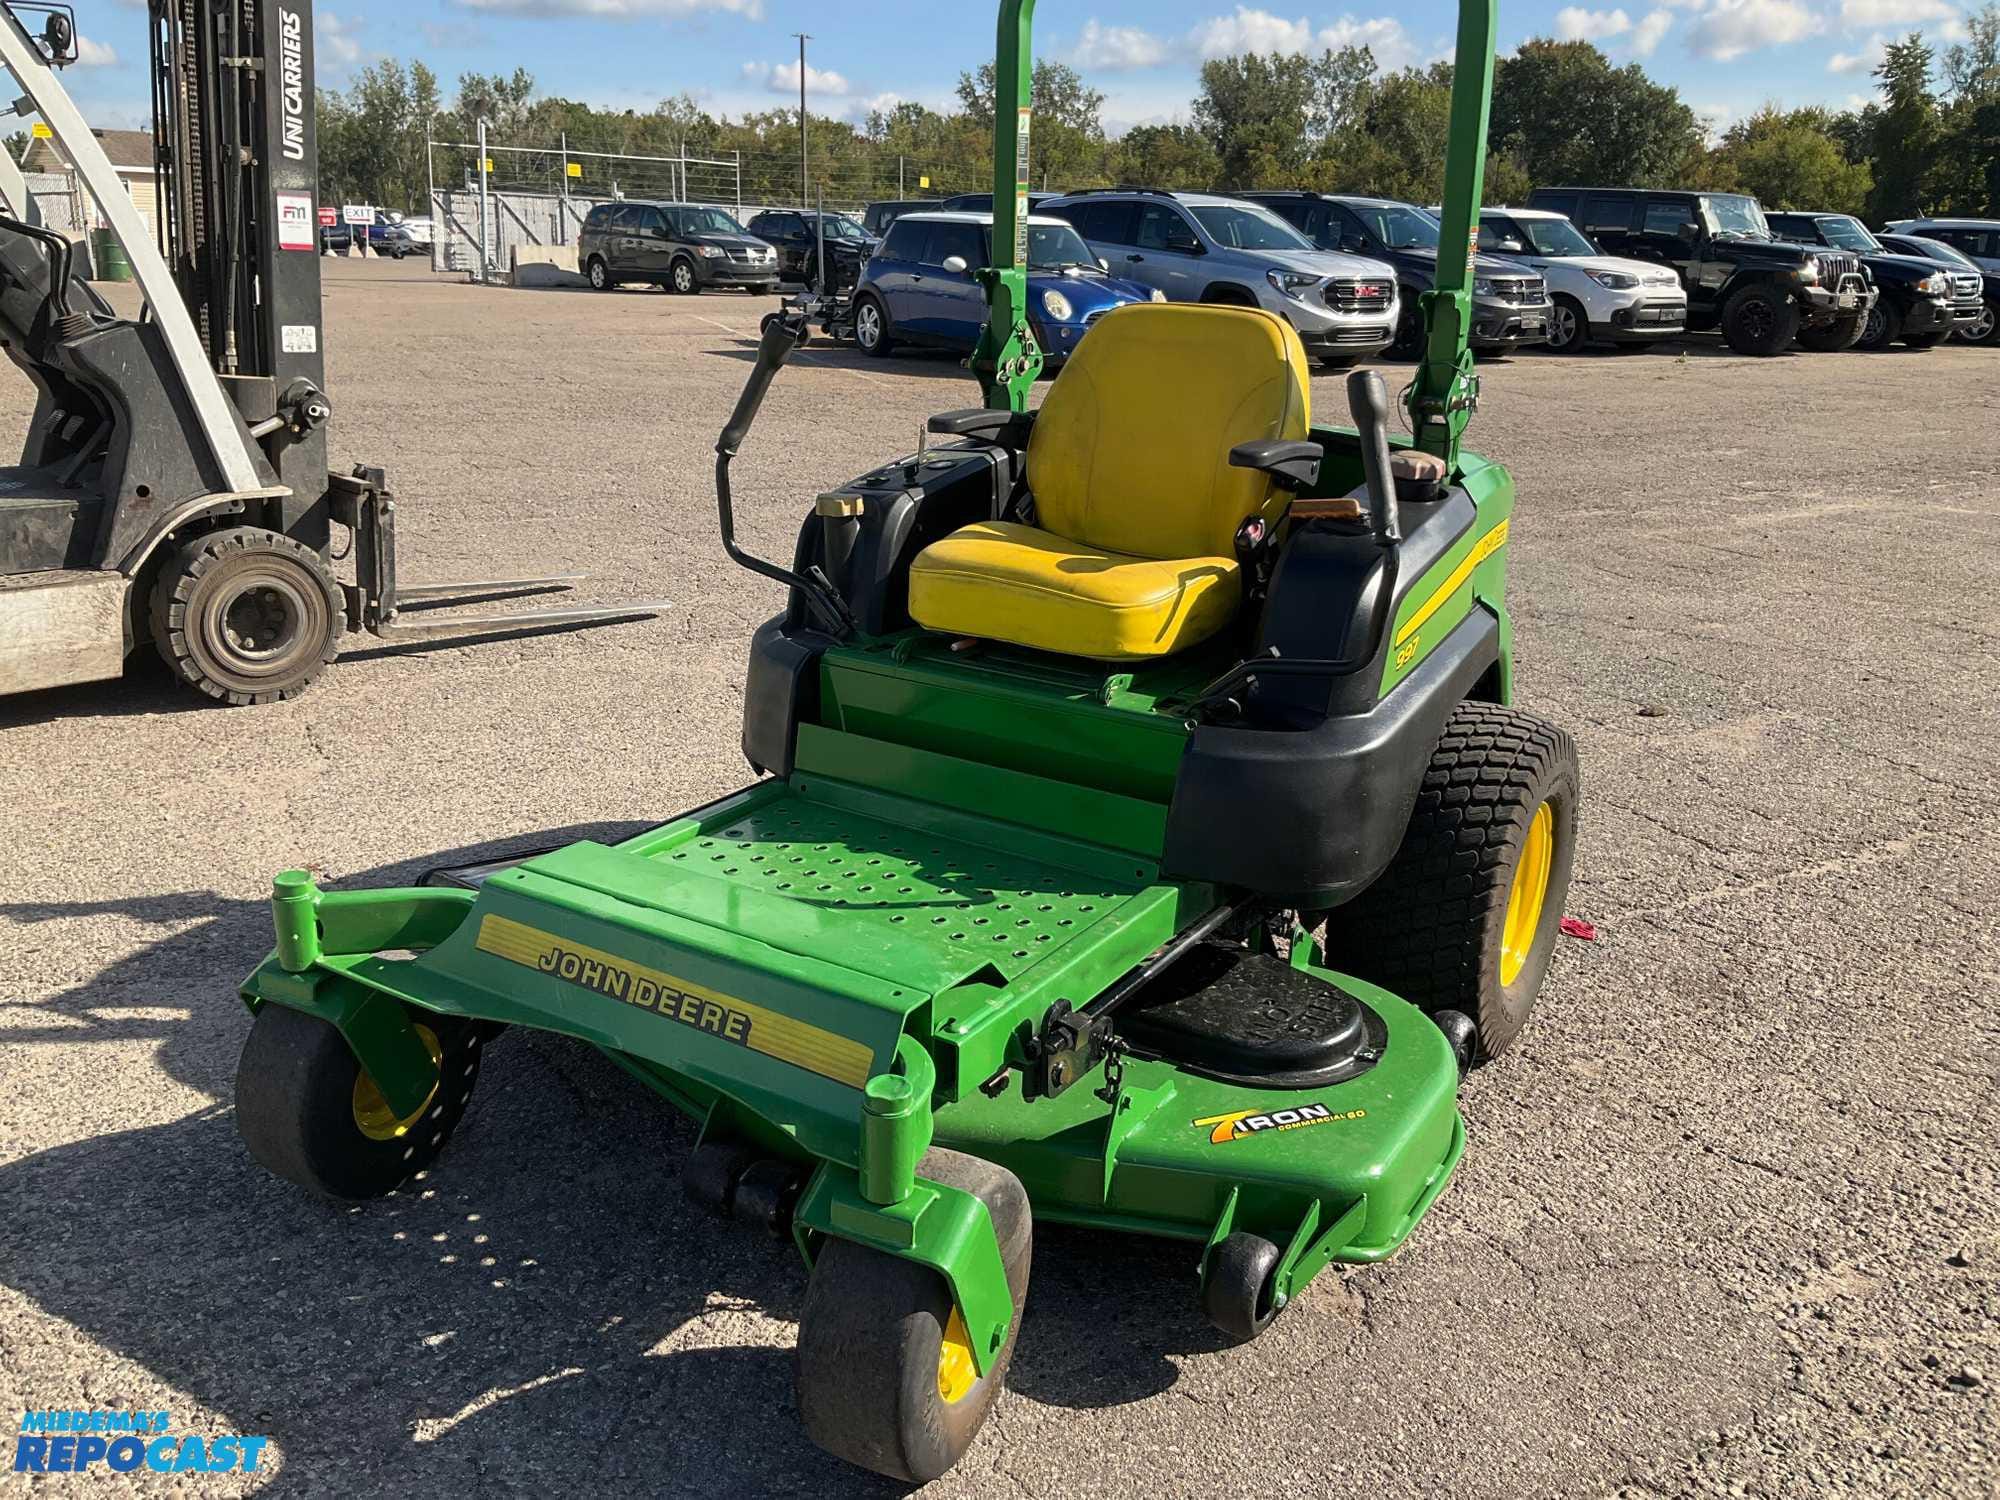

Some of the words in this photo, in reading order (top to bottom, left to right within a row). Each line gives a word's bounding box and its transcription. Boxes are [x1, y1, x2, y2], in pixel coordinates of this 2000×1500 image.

[281, 9, 304, 160] UNICARRIERS
[345, 208, 372, 217] EXIT
[1354, 286, 1379, 298] GMC
[1395, 635, 1420, 671] 997
[538, 948, 632, 1002] JOHN
[632, 977, 752, 1046] DEERE
[1278, 1114, 1345, 1131] COMMERCIAL
